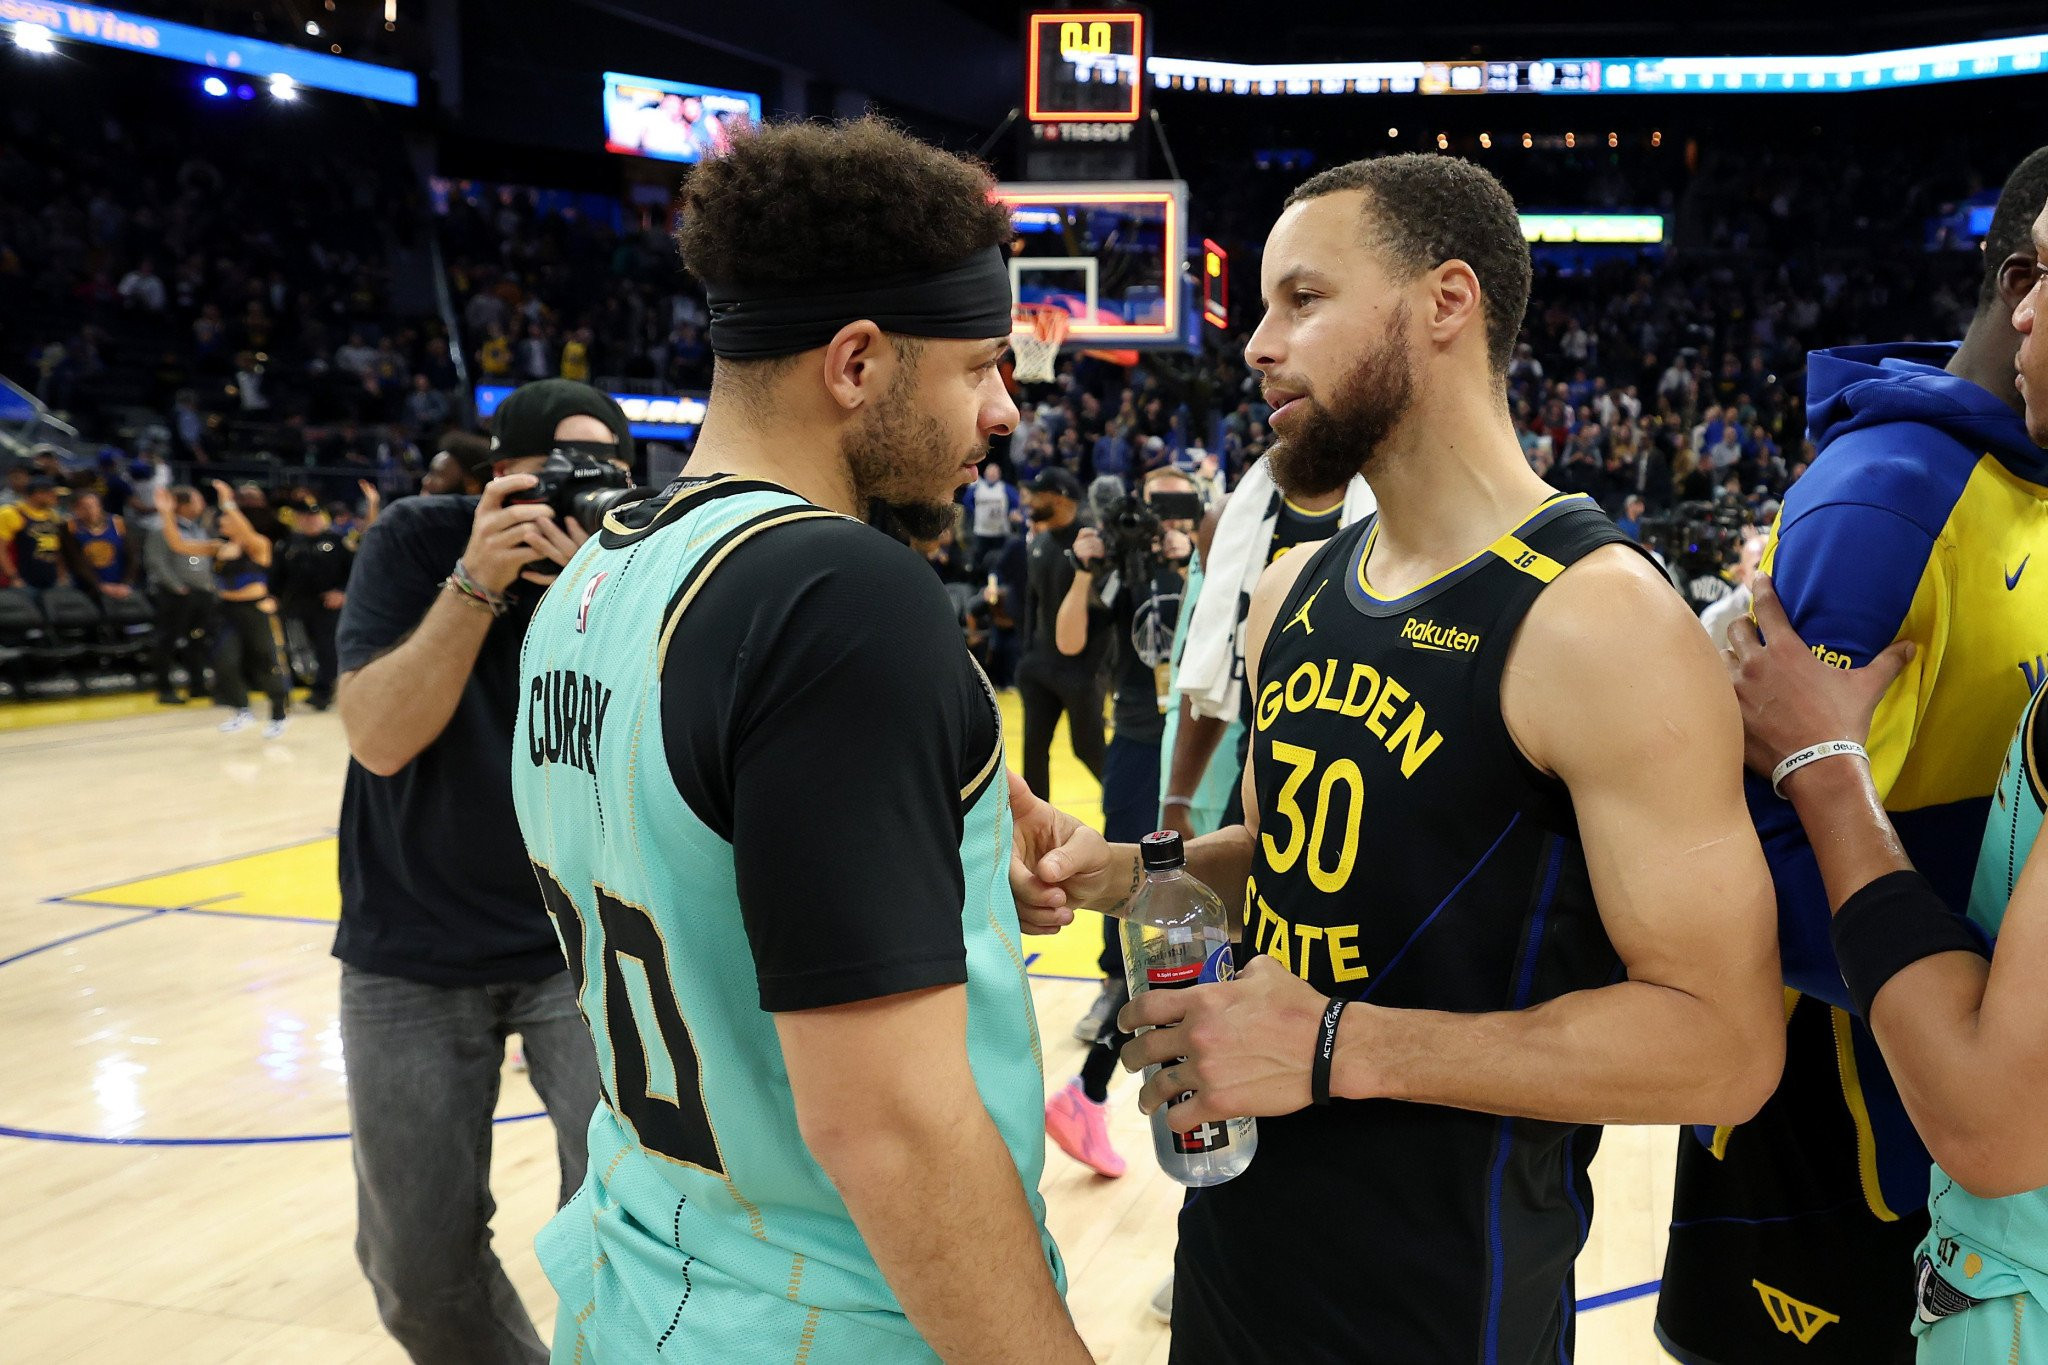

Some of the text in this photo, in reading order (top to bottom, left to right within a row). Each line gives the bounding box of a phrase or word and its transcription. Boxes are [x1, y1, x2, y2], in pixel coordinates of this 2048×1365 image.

[66, 6, 160, 49] Wins
[573, 468, 602, 478] Nikon
[1513, 550, 1538, 569] 16
[1400, 617, 1480, 653] Rakuten
[528, 669, 612, 776] CURRY
[1256, 657, 1444, 780] GOLDEN
[1261, 739, 1365, 894] 30
[1243, 875, 1369, 983] STATE
[1323, 1028, 1334, 1060] ACTIVE
